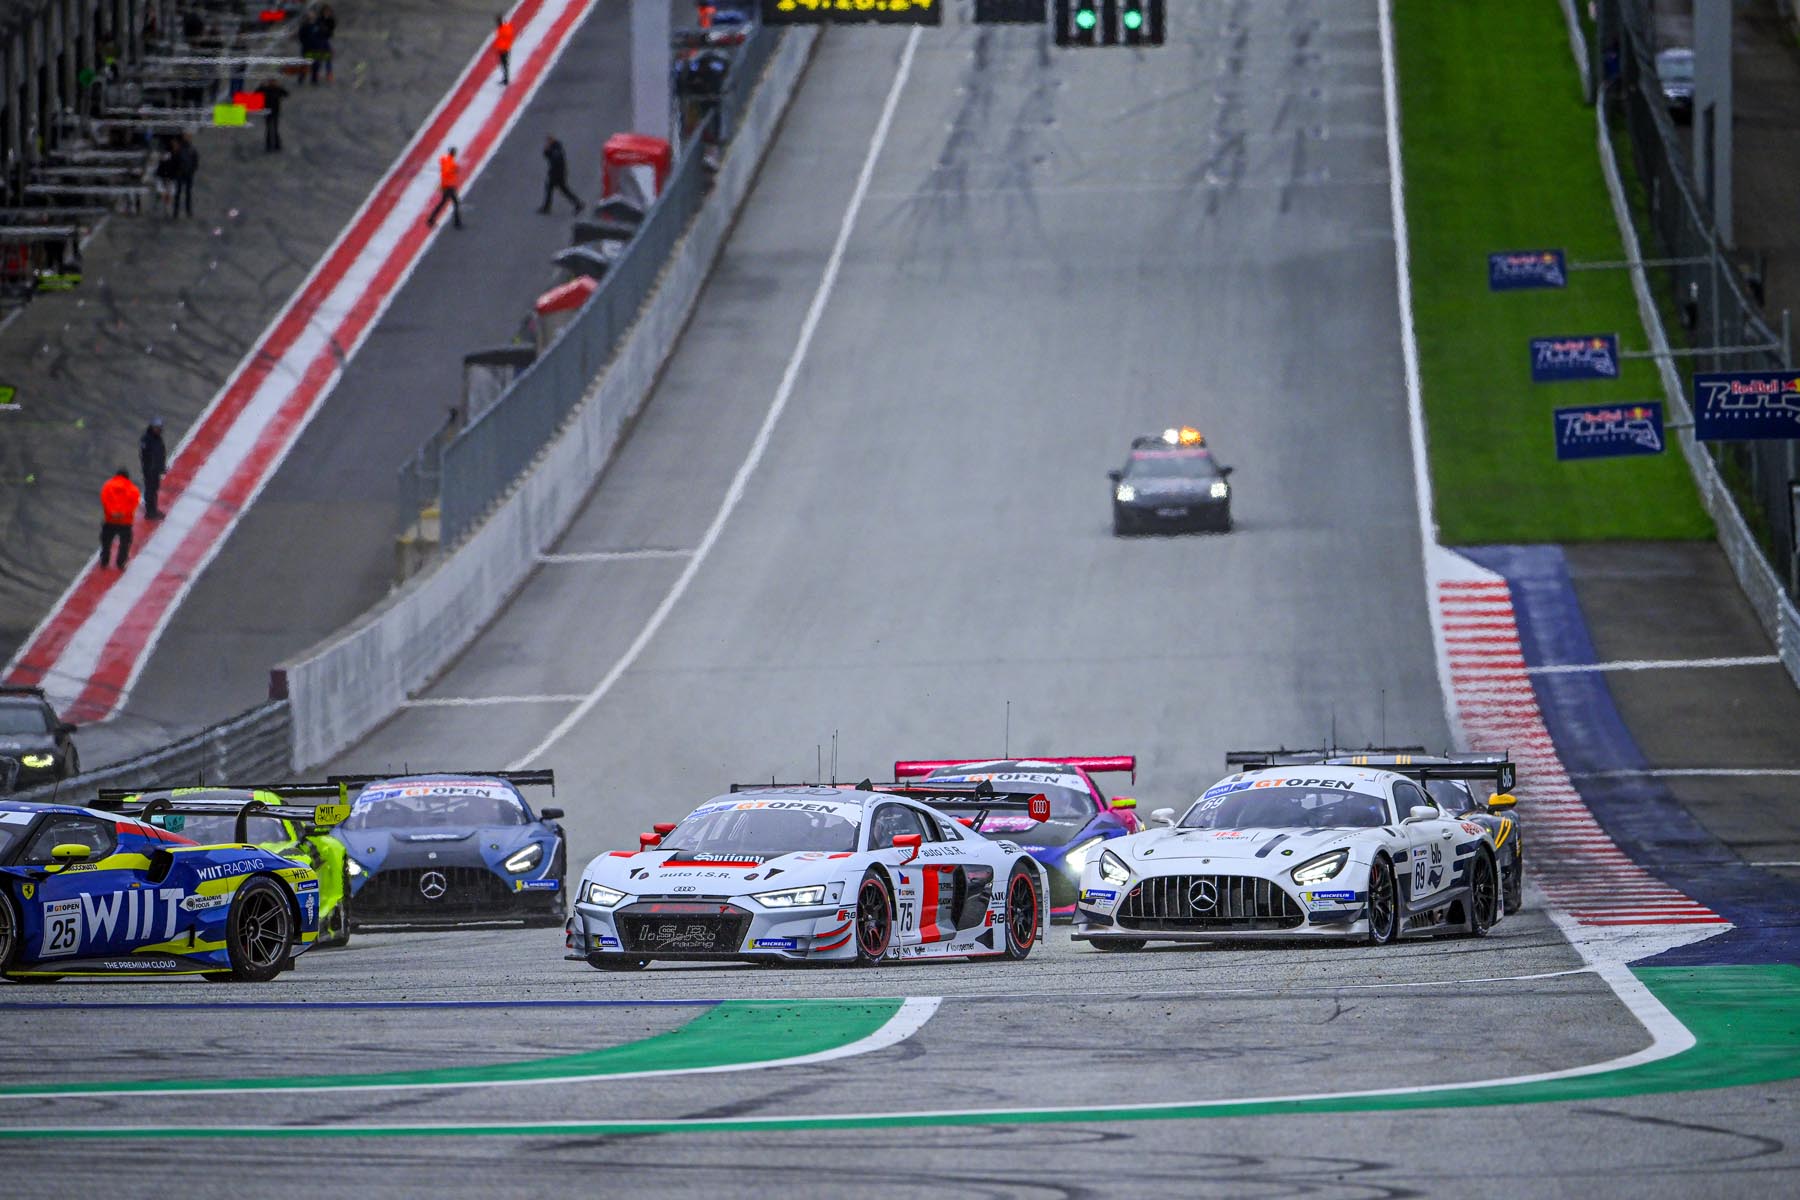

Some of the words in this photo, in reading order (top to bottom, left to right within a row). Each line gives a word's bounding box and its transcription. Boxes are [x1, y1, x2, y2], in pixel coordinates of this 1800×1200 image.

[1731, 380, 1755, 394] Red
[1756, 379, 1778, 393] Bull
[319, 806, 334, 814] WIIT
[1201, 796, 1227, 811] 69
[318, 813, 342, 822] RACING
[921, 848, 942, 858] auto
[197, 863, 223, 880] WIIT
[223, 858, 265, 876] RACING
[292, 869, 310, 880] WIIT
[659, 871, 692, 879] auto
[696, 871, 732, 879] I.S.R.
[1415, 861, 1425, 890] 69
[195, 901, 210, 909] FOCUS
[80, 887, 185, 944] WIIT
[900, 902, 913, 932] 75
[50, 917, 77, 950] 25
[104, 961, 118, 969] THE
[119, 961, 150, 969] PREMIUM
[151, 960, 176, 969] CLOUD
